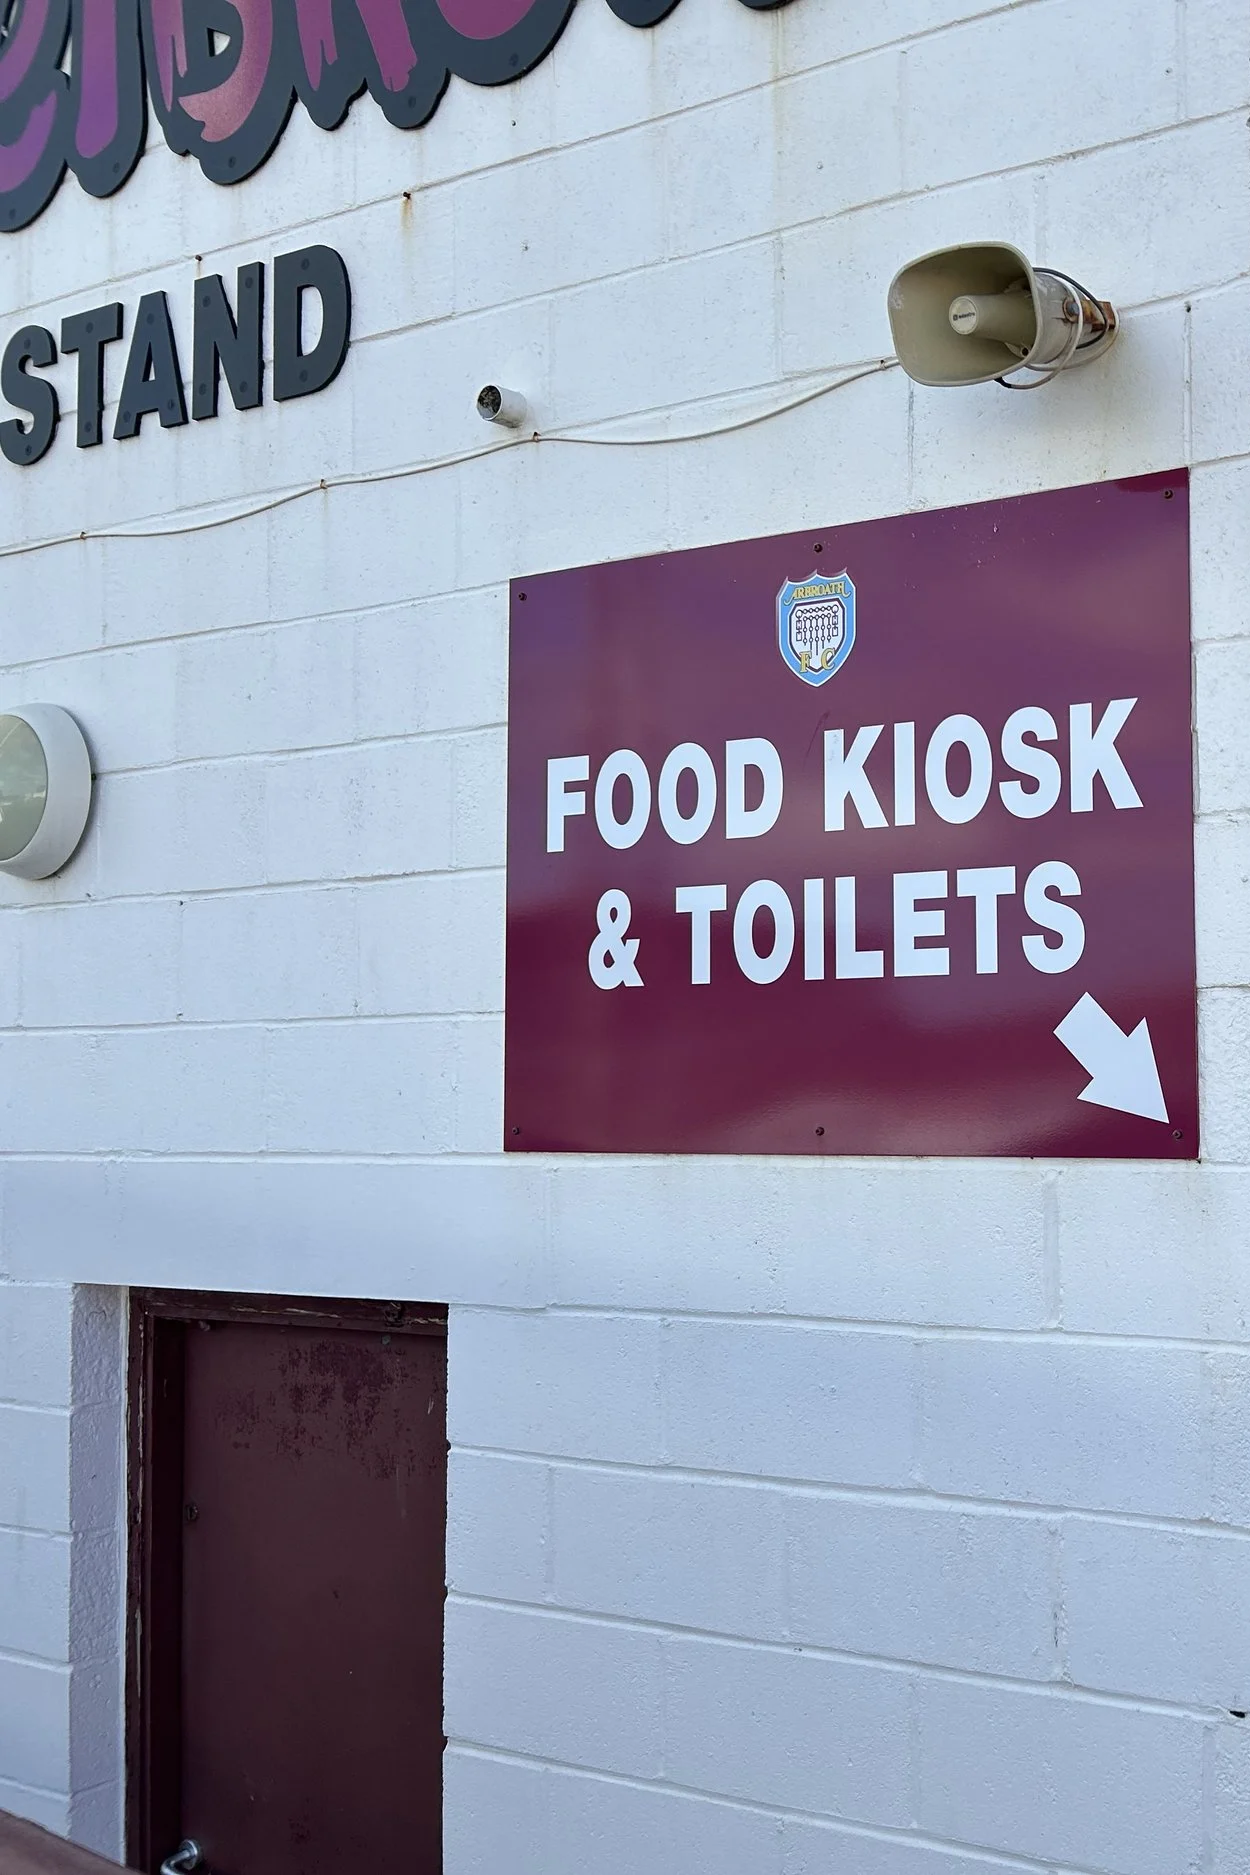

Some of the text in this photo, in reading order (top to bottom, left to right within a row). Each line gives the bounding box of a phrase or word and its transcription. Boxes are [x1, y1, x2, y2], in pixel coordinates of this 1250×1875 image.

[0, 244, 352, 466] STAND
[784, 581, 851, 605] ARBROATH
[547, 697, 1144, 853] FOOD KIOSK
[588, 860, 1086, 990] & TOILETS
